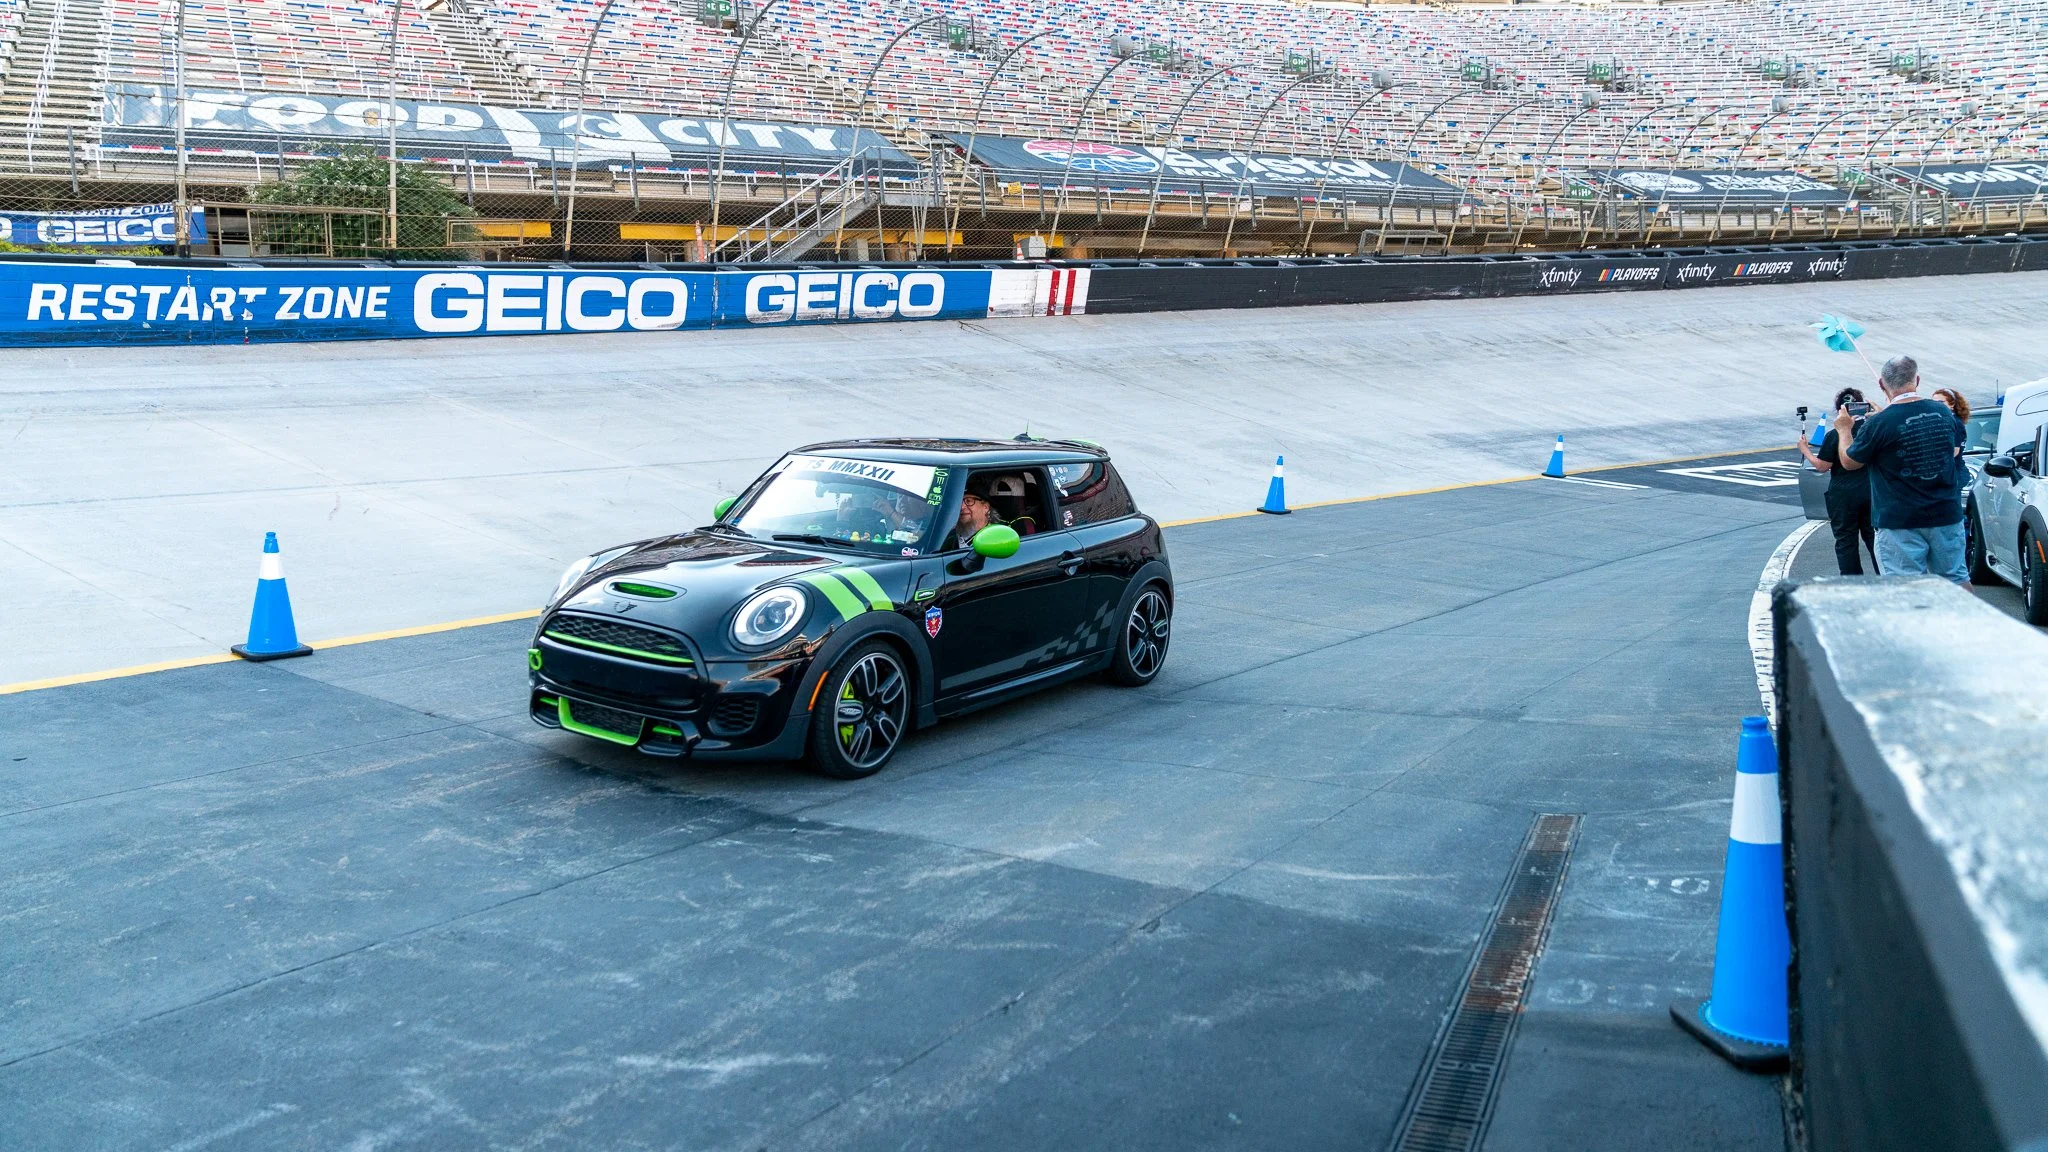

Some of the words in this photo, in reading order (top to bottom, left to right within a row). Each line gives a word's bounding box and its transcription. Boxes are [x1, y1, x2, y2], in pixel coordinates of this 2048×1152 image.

[191, 93, 484, 132] FOOD
[658, 119, 838, 151] CITY
[1144, 147, 1392, 179] Bristol
[1926, 170, 2017, 185] FOOD
[1540, 265, 1581, 287] xfinity
[1611, 267, 1660, 281] PLAYOFFS
[1676, 263, 1716, 280] xfinity
[1748, 261, 1793, 275] PLAYOFFS
[1807, 257, 1847, 275] xfinity
[26, 282, 268, 321] RESTART
[274, 285, 391, 320] ZONE
[413, 273, 688, 332] GEICO
[745, 272, 944, 321] GEICO
[828, 460, 896, 481] MMXXII
